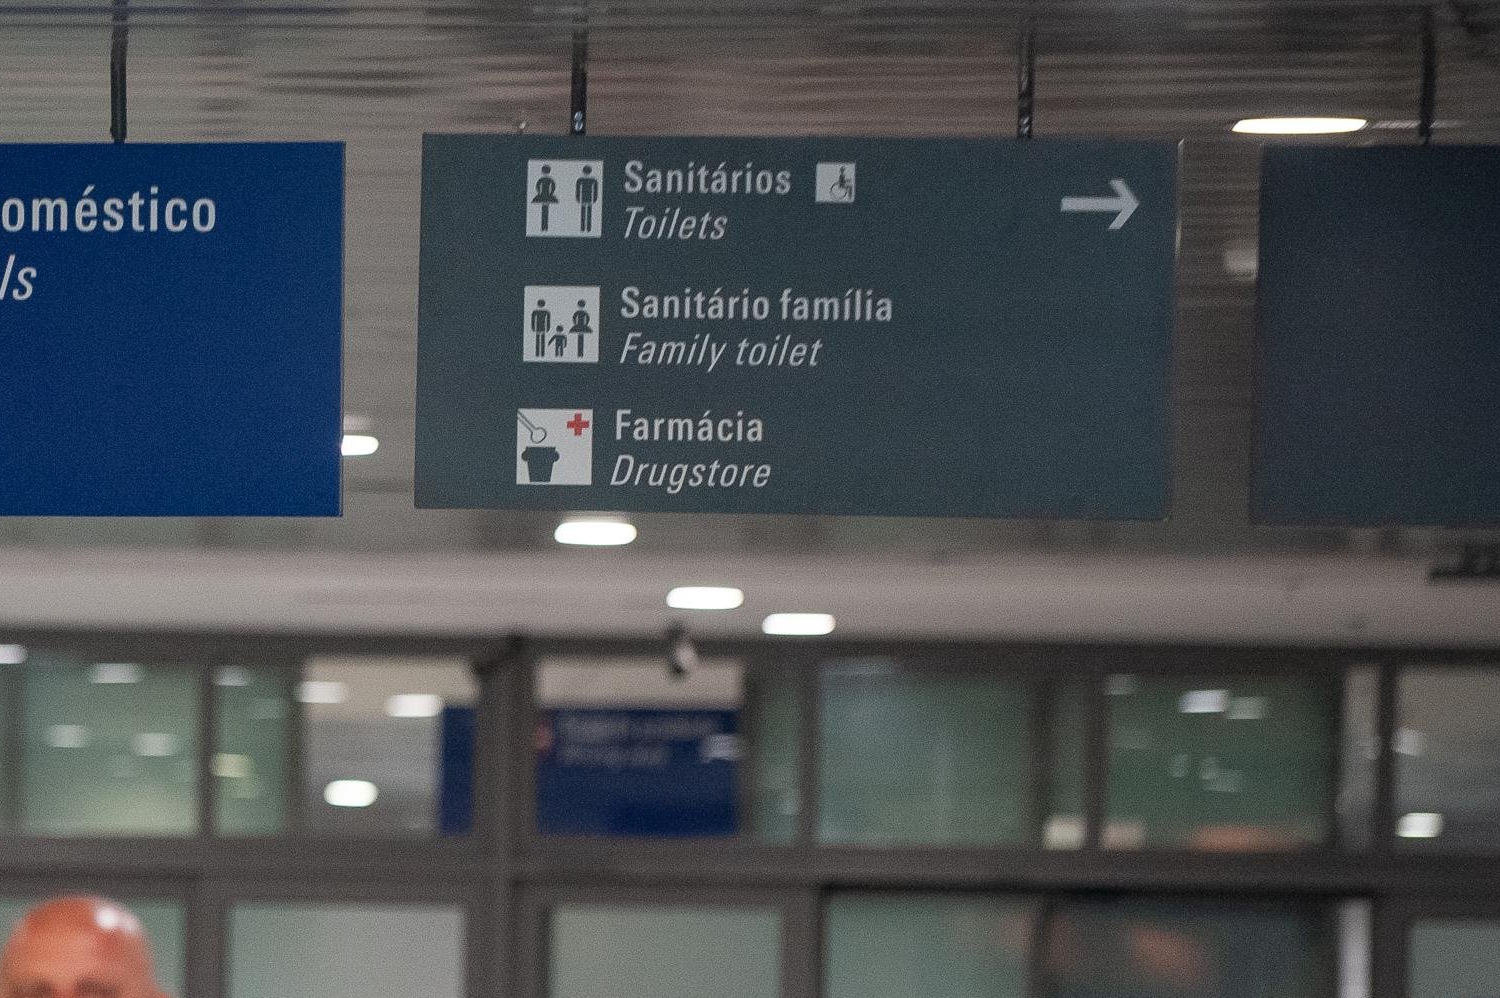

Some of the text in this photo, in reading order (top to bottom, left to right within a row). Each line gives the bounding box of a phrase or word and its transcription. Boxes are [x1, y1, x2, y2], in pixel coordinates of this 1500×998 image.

[623, 159, 792, 195] Sanitários
[624, 206, 728, 240] Toilets
[620, 286, 893, 321] Sanitário família
[619, 331, 823, 373] Family toilet
[614, 408, 763, 442] Farmácia
[609, 454, 772, 495] Drugstore
